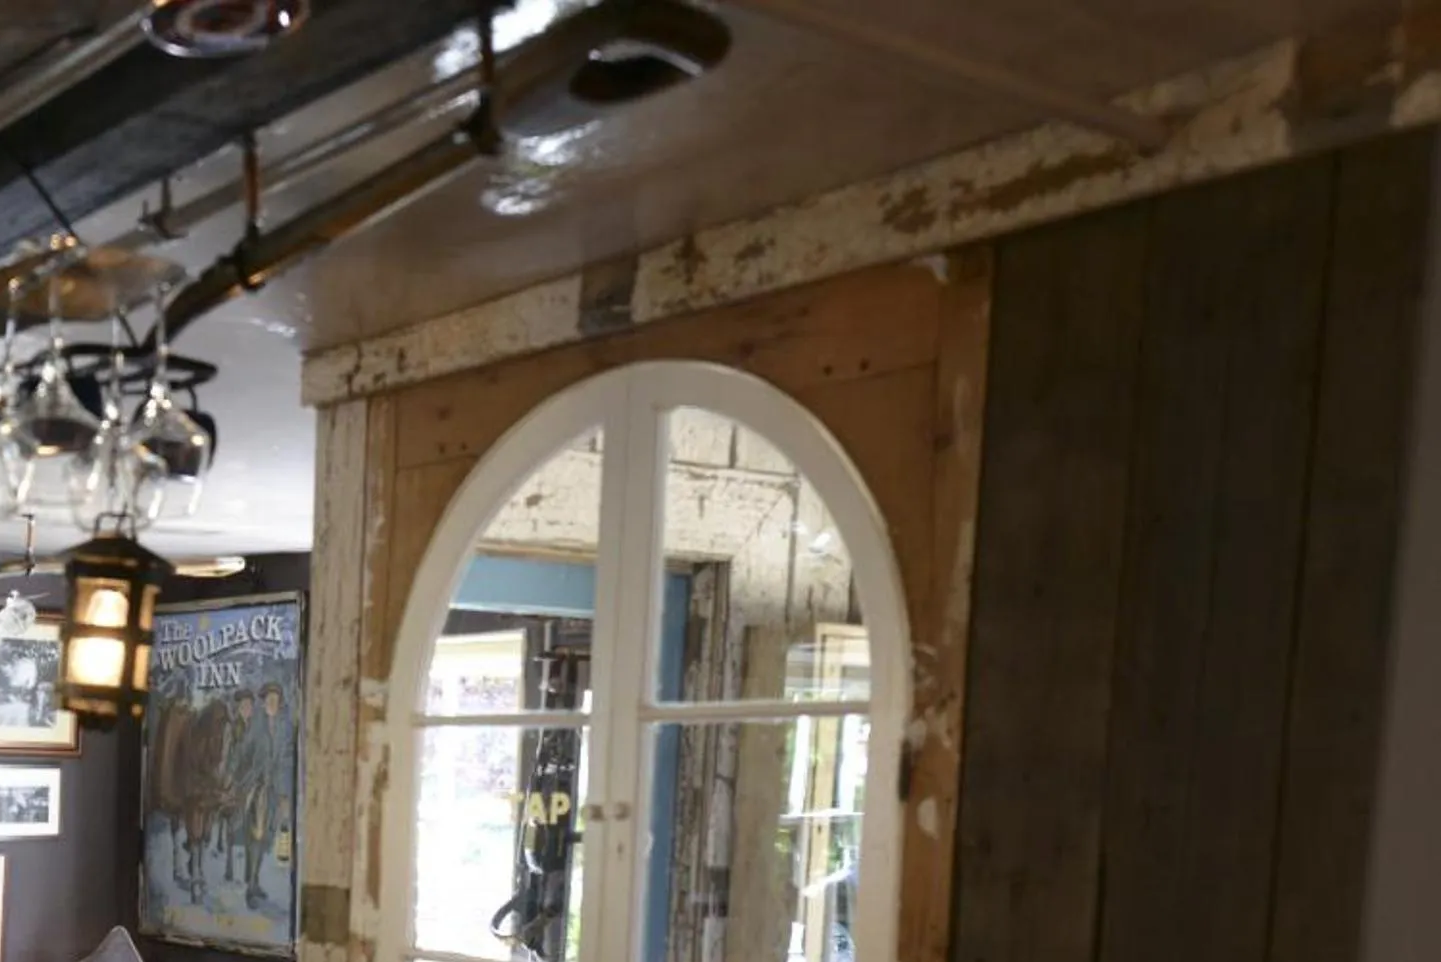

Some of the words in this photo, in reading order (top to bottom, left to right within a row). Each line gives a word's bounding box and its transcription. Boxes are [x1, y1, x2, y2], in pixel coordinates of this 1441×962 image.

[160, 619, 193, 642] The
[160, 614, 284, 671] WOOLPACK
[198, 661, 243, 687] INN
